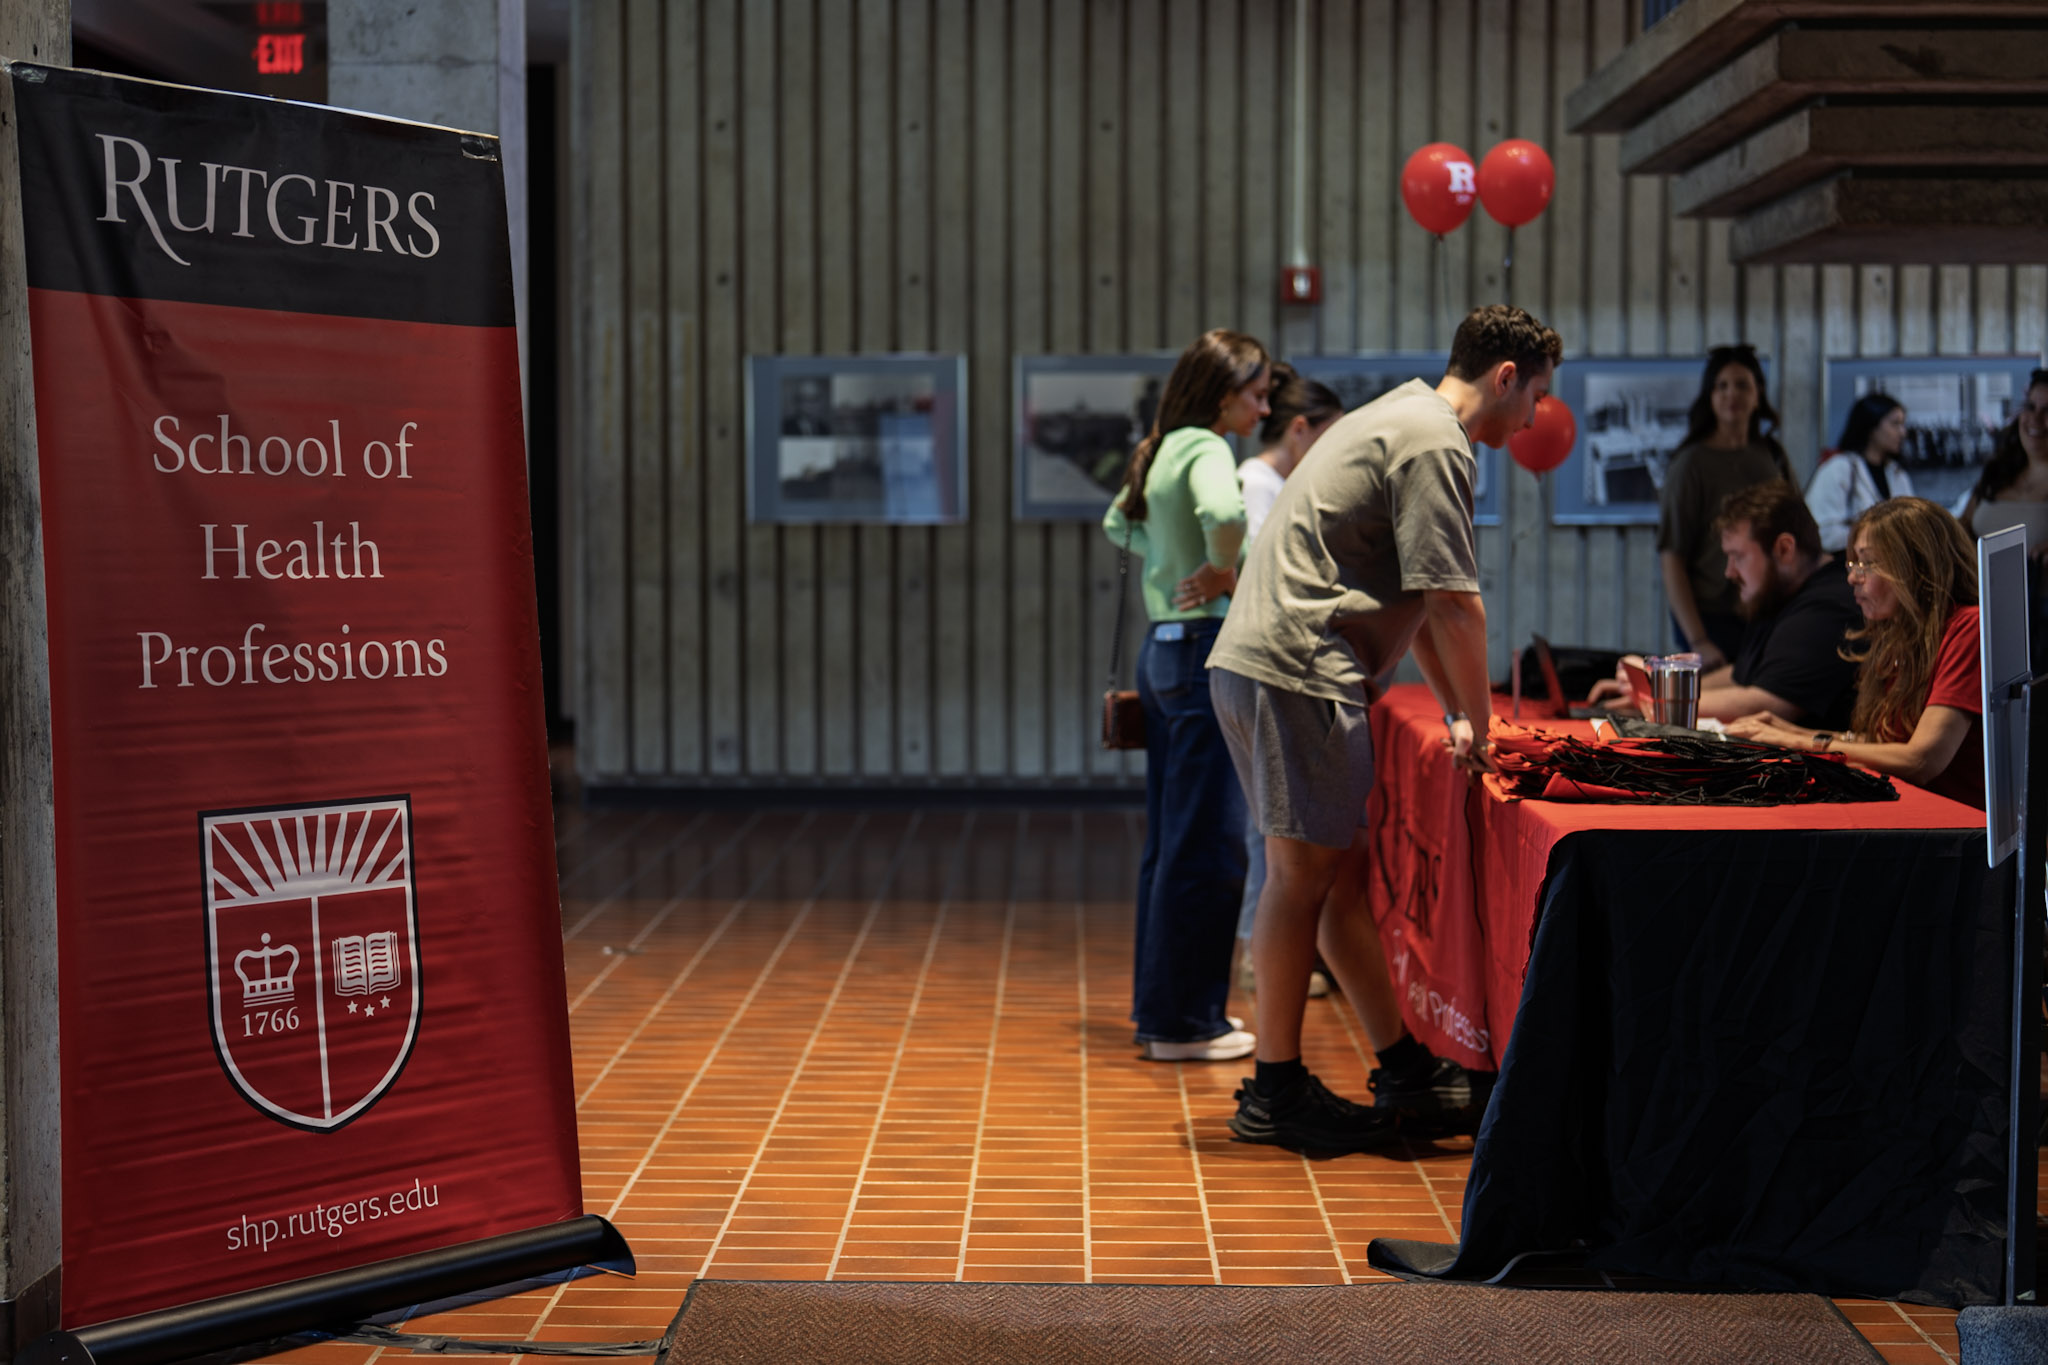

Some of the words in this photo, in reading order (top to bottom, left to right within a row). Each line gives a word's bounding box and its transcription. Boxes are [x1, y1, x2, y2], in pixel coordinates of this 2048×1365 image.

[258, 34, 305, 74] EXIT
[95, 133, 440, 266] RUTGERS
[1443, 161, 1476, 193] R
[152, 414, 346, 476] School
[363, 421, 418, 479] of
[200, 520, 384, 580] Health
[137, 623, 448, 689] Professions
[242, 1007, 300, 1037] 1766
[227, 1178, 439, 1252] shp.rutgers.edu
